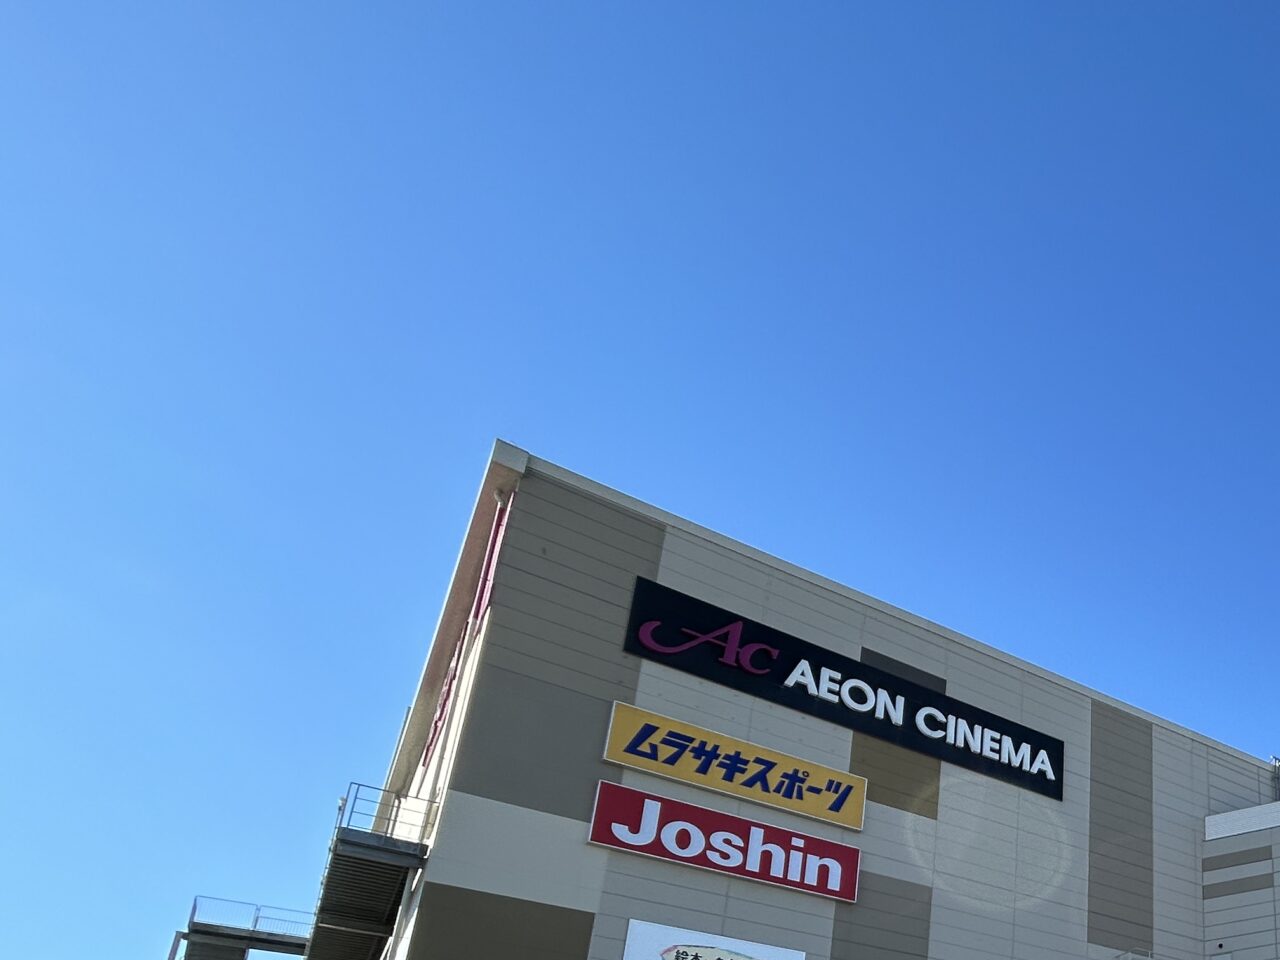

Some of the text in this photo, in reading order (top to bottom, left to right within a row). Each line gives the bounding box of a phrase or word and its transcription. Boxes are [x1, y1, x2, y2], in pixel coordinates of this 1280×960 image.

[783, 659, 1056, 781] AEON CINEMA
[623, 723, 854, 813] ムラサキスポーツ
[610, 799, 842, 891] Joshin
